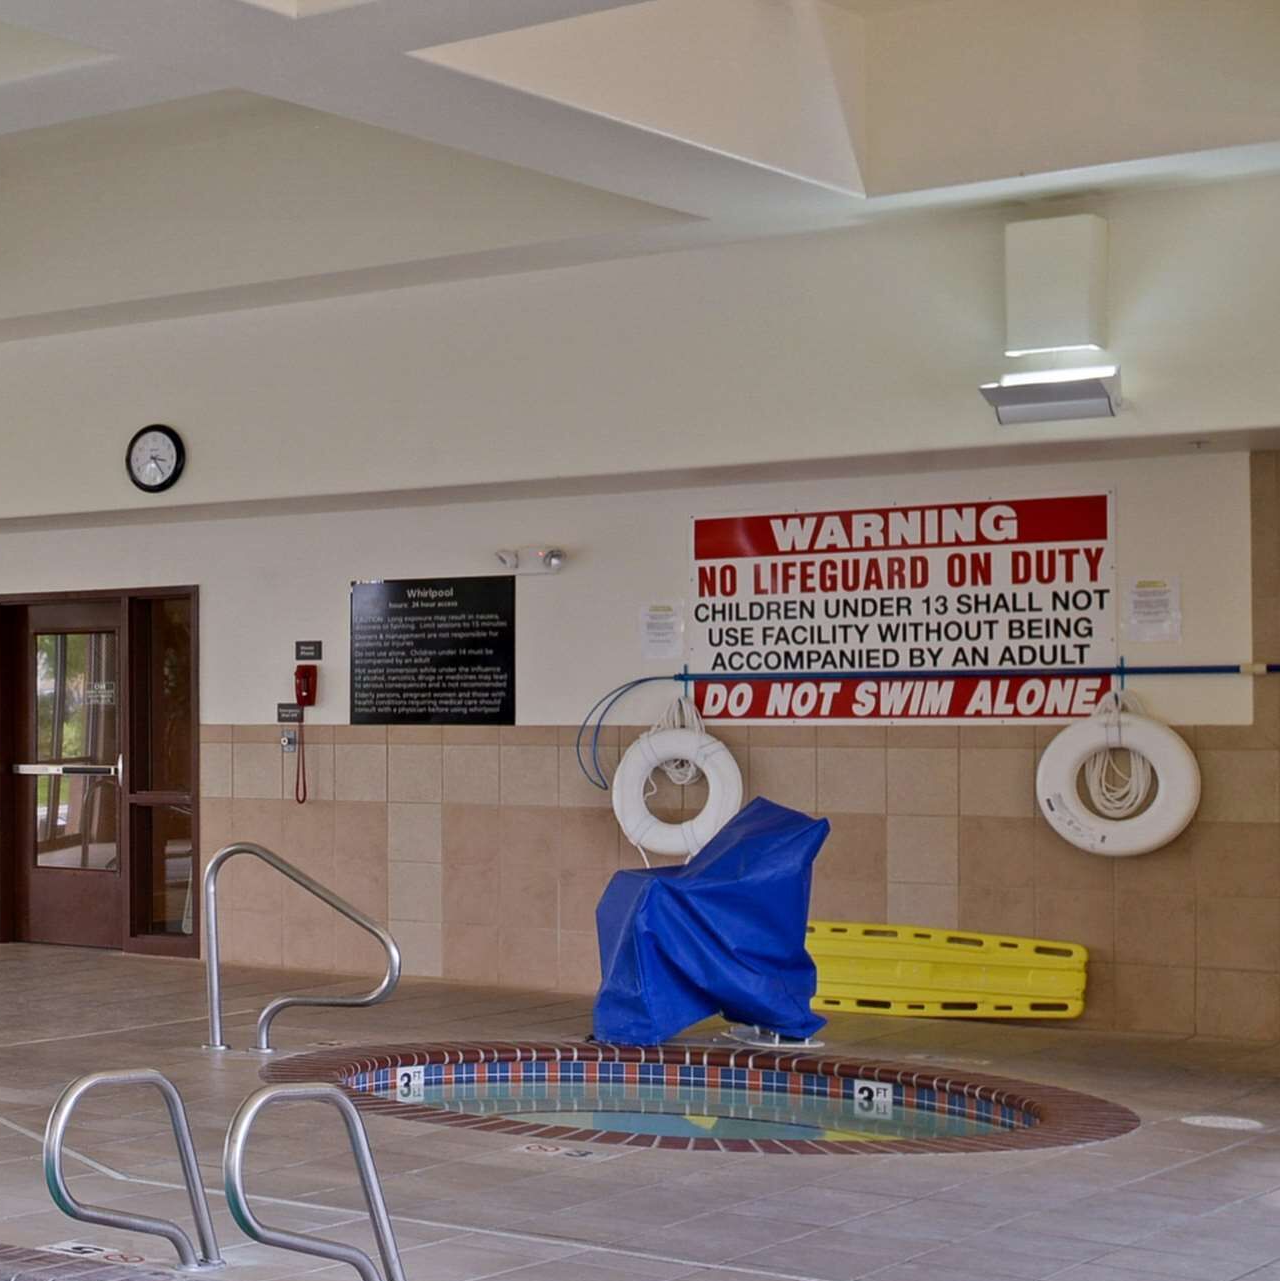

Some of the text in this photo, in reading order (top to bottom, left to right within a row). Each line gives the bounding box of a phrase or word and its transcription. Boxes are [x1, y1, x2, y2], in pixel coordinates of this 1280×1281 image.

[770, 505, 1018, 551] WARNING
[698, 547, 1105, 597] NO LIFEGUARD ON DUTY
[407, 588, 453, 599] Whirlpool
[694, 600, 815, 623] CHILDREN
[824, 596, 912, 618] UNDER
[922, 596, 948, 615] 13
[957, 592, 1042, 614] SHALL
[1052, 589, 1110, 610] NOT
[405, 615, 432, 623] exposure
[708, 617, 1093, 647] USE FACILITY WITHOUT BEING
[385, 633, 425, 641] management
[396, 657, 403, 665] by
[711, 644, 1090, 672] ACCOMPANIED BY AN ADULT
[703, 683, 752, 716] DO
[766, 681, 841, 716] NOT
[851, 680, 955, 716] SWIM
[858, 1086, 888, 1102] 3 FT
